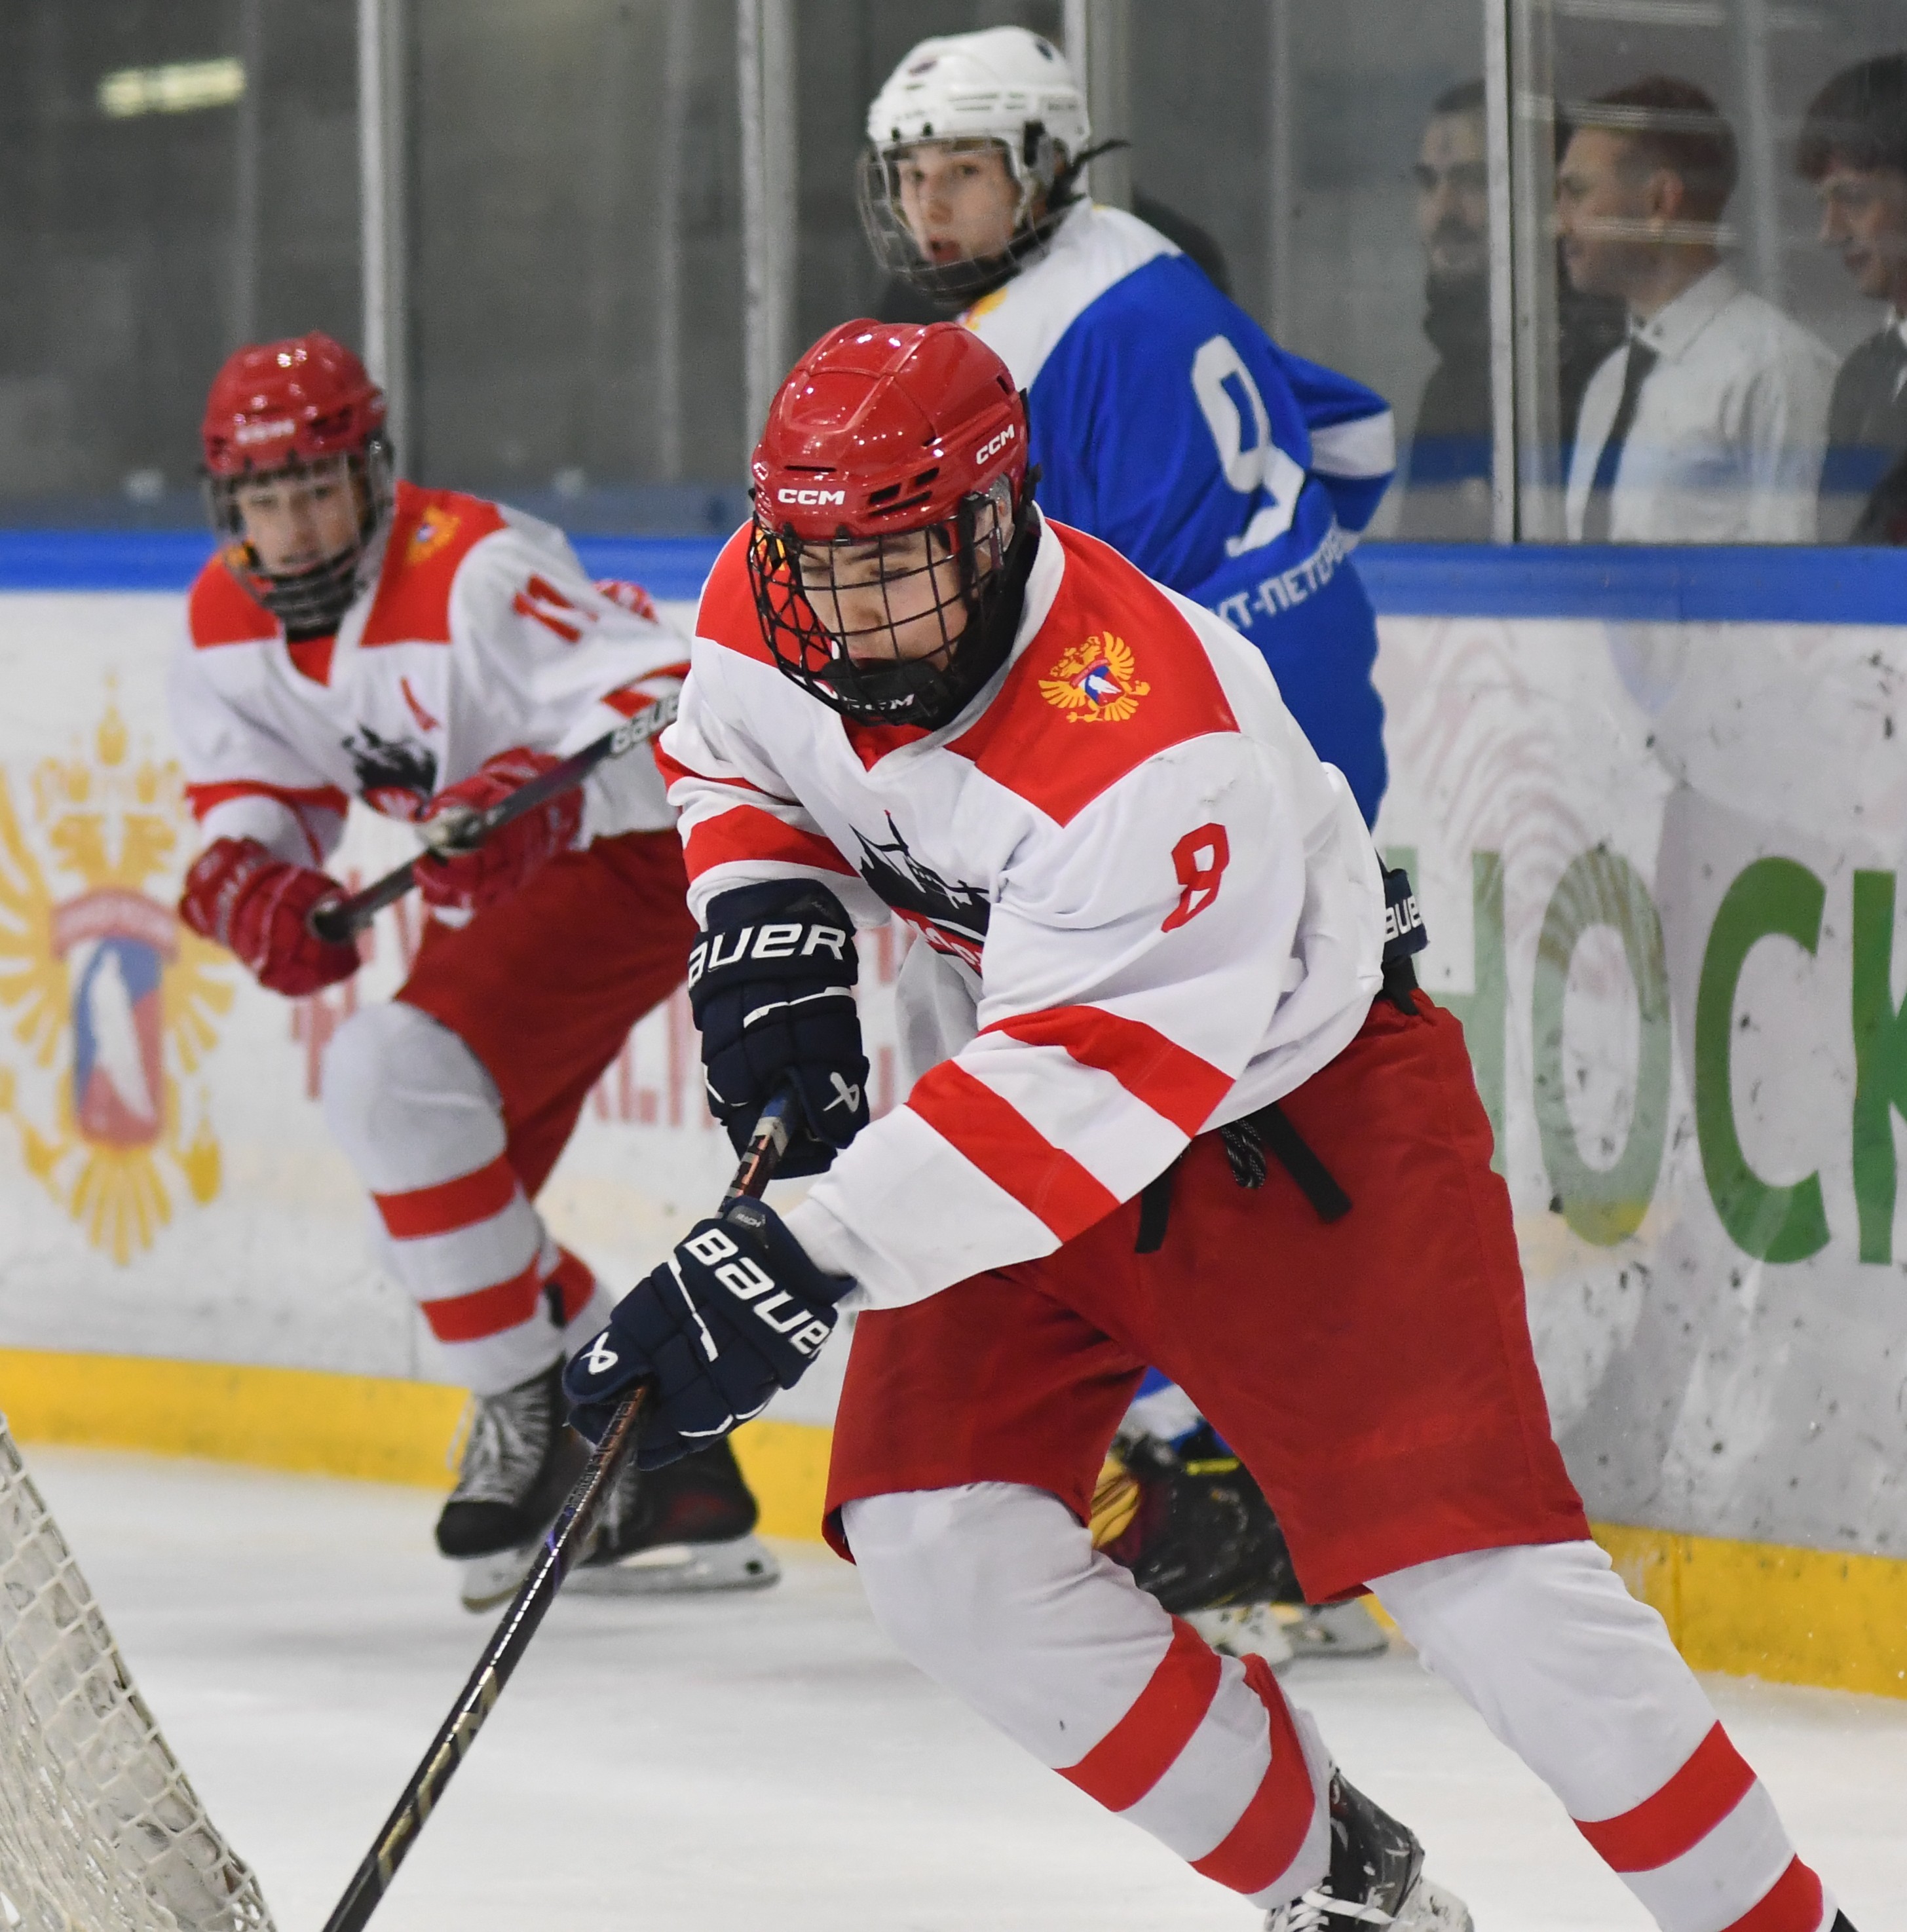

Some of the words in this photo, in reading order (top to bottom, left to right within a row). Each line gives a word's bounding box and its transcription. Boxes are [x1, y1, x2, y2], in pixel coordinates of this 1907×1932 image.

[975, 424, 1015, 465] CCM
[1190, 334, 1306, 558] 9
[778, 488, 845, 505] CCM
[1161, 823, 1230, 933] 8
[1384, 895, 1422, 943] AUE
[688, 922, 846, 989] AUER
[1384, 845, 1907, 1266] НОСК
[683, 1228, 831, 1359] BAUE
